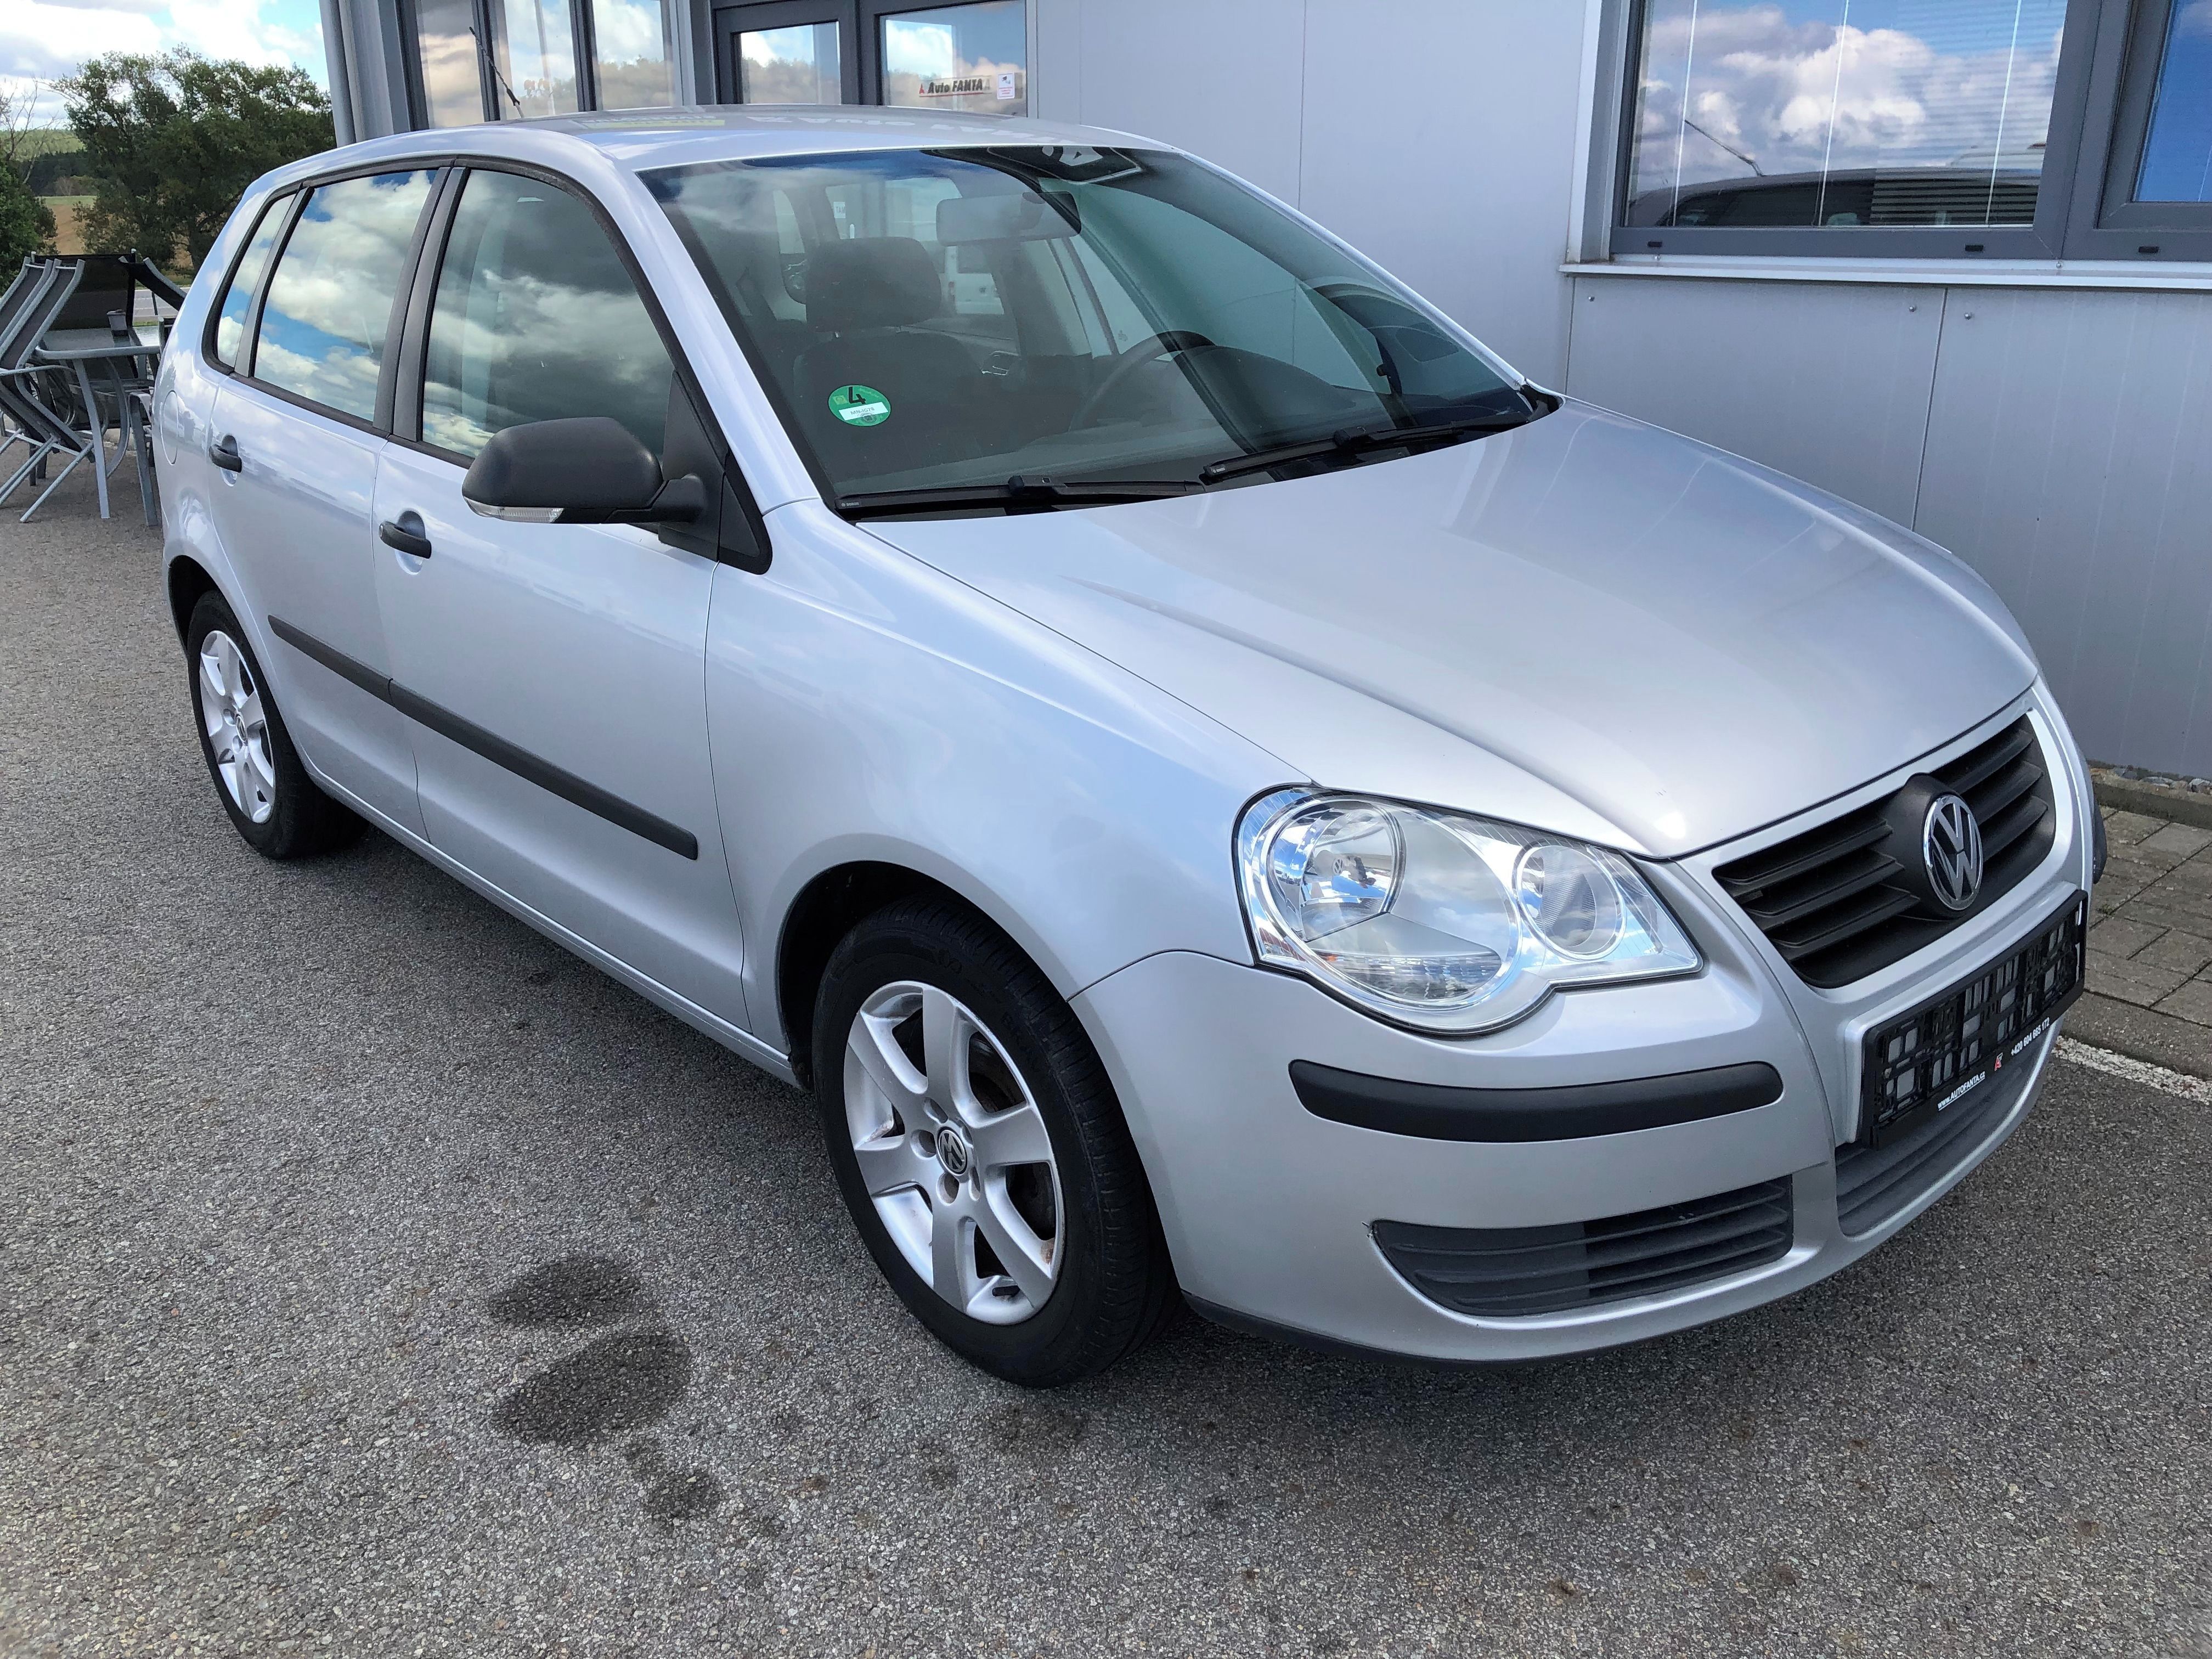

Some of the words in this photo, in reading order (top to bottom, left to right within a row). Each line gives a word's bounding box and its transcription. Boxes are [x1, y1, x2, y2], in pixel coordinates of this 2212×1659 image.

[928, 82, 950, 94] Auto
[952, 78, 983, 92] FANTA
[849, 386, 866, 404] 4
